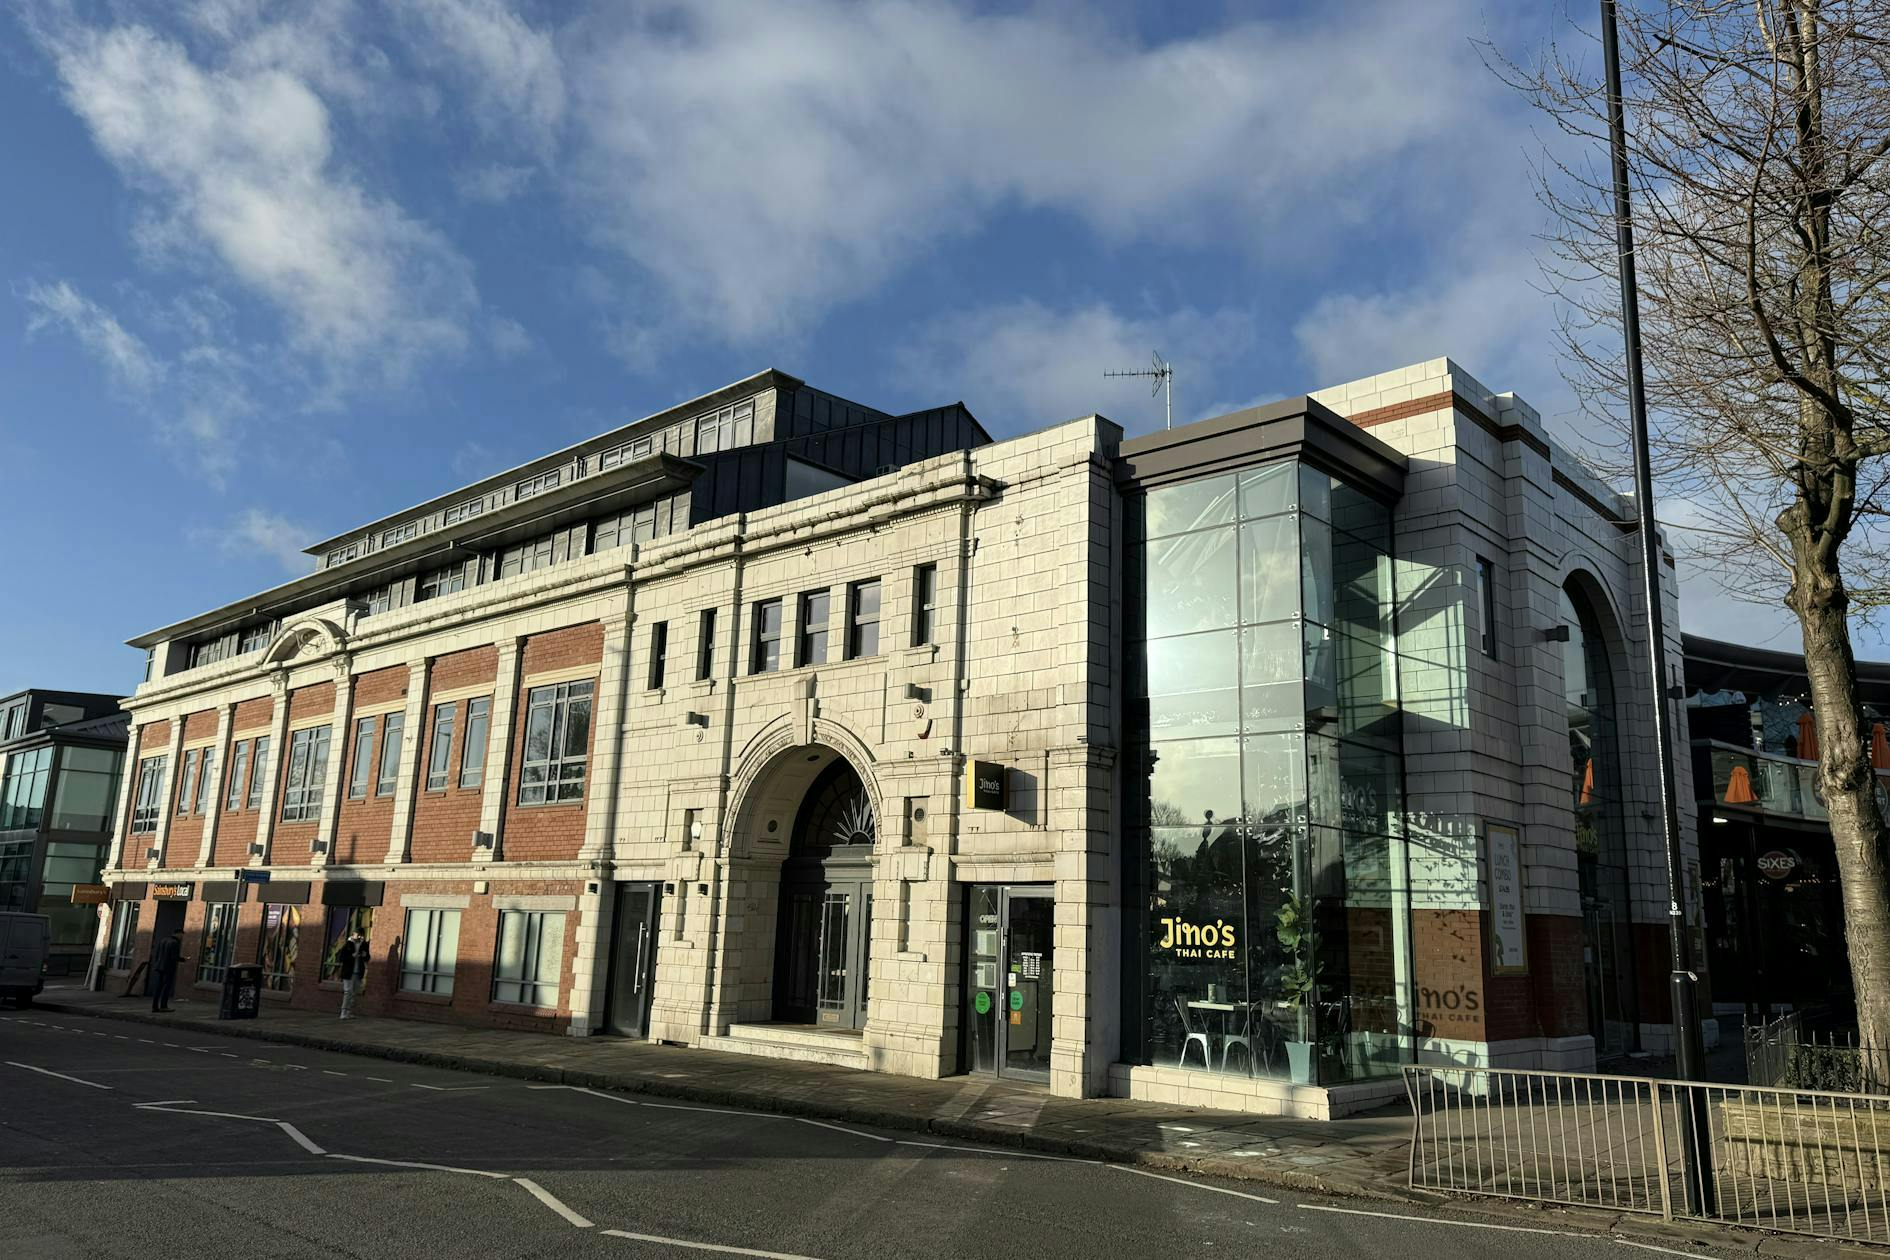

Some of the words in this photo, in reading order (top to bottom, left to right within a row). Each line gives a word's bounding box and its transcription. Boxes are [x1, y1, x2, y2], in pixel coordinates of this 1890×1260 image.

[979, 778, 1000, 791] Jino's
[1494, 853, 1510, 867] LUNCH
[1757, 856, 1796, 870] SIXES
[1494, 867, 1512, 881] COMBO
[153, 884, 177, 898] Sainsbury's
[176, 884, 190, 897] Local
[1160, 916, 1236, 949] Jino's
[1176, 948, 1202, 958] THAI
[1206, 949, 1236, 959] CAFE
